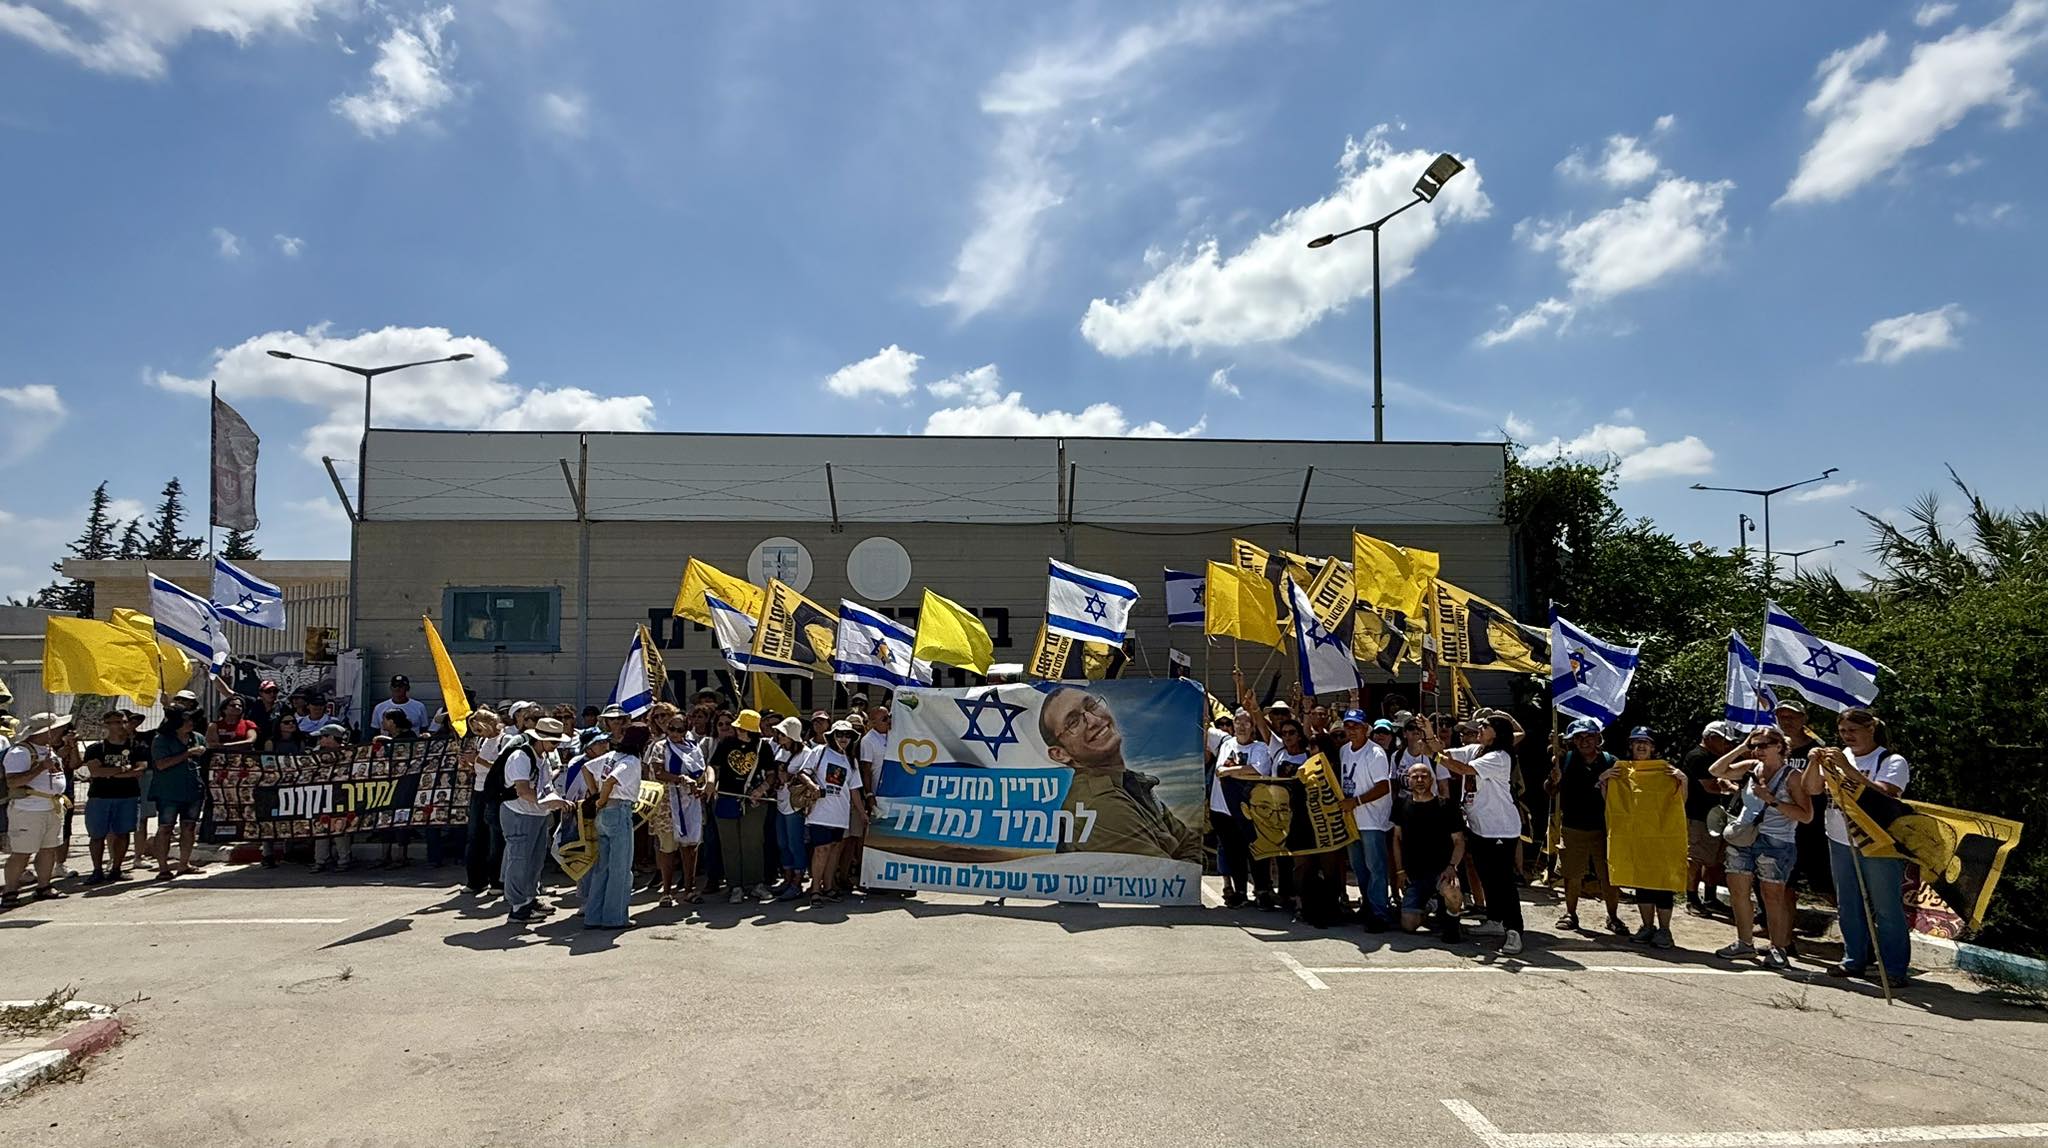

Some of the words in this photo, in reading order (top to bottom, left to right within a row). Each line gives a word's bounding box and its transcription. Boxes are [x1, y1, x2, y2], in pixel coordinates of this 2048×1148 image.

[336, 780, 398, 813] נחזיר.
[920, 775, 994, 801] מחכים
[1000, 777, 1059, 808] עדיין
[271, 784, 333, 819] נקום.
[992, 802, 1097, 843] לתמיר
[877, 861, 951, 885] חוזרים.
[956, 864, 1028, 891] שכולם
[1032, 873, 1060, 894] עד
[1064, 875, 1088, 896] עד
[1161, 874, 1187, 898] לא
[1093, 876, 1156, 898] עוצרים
